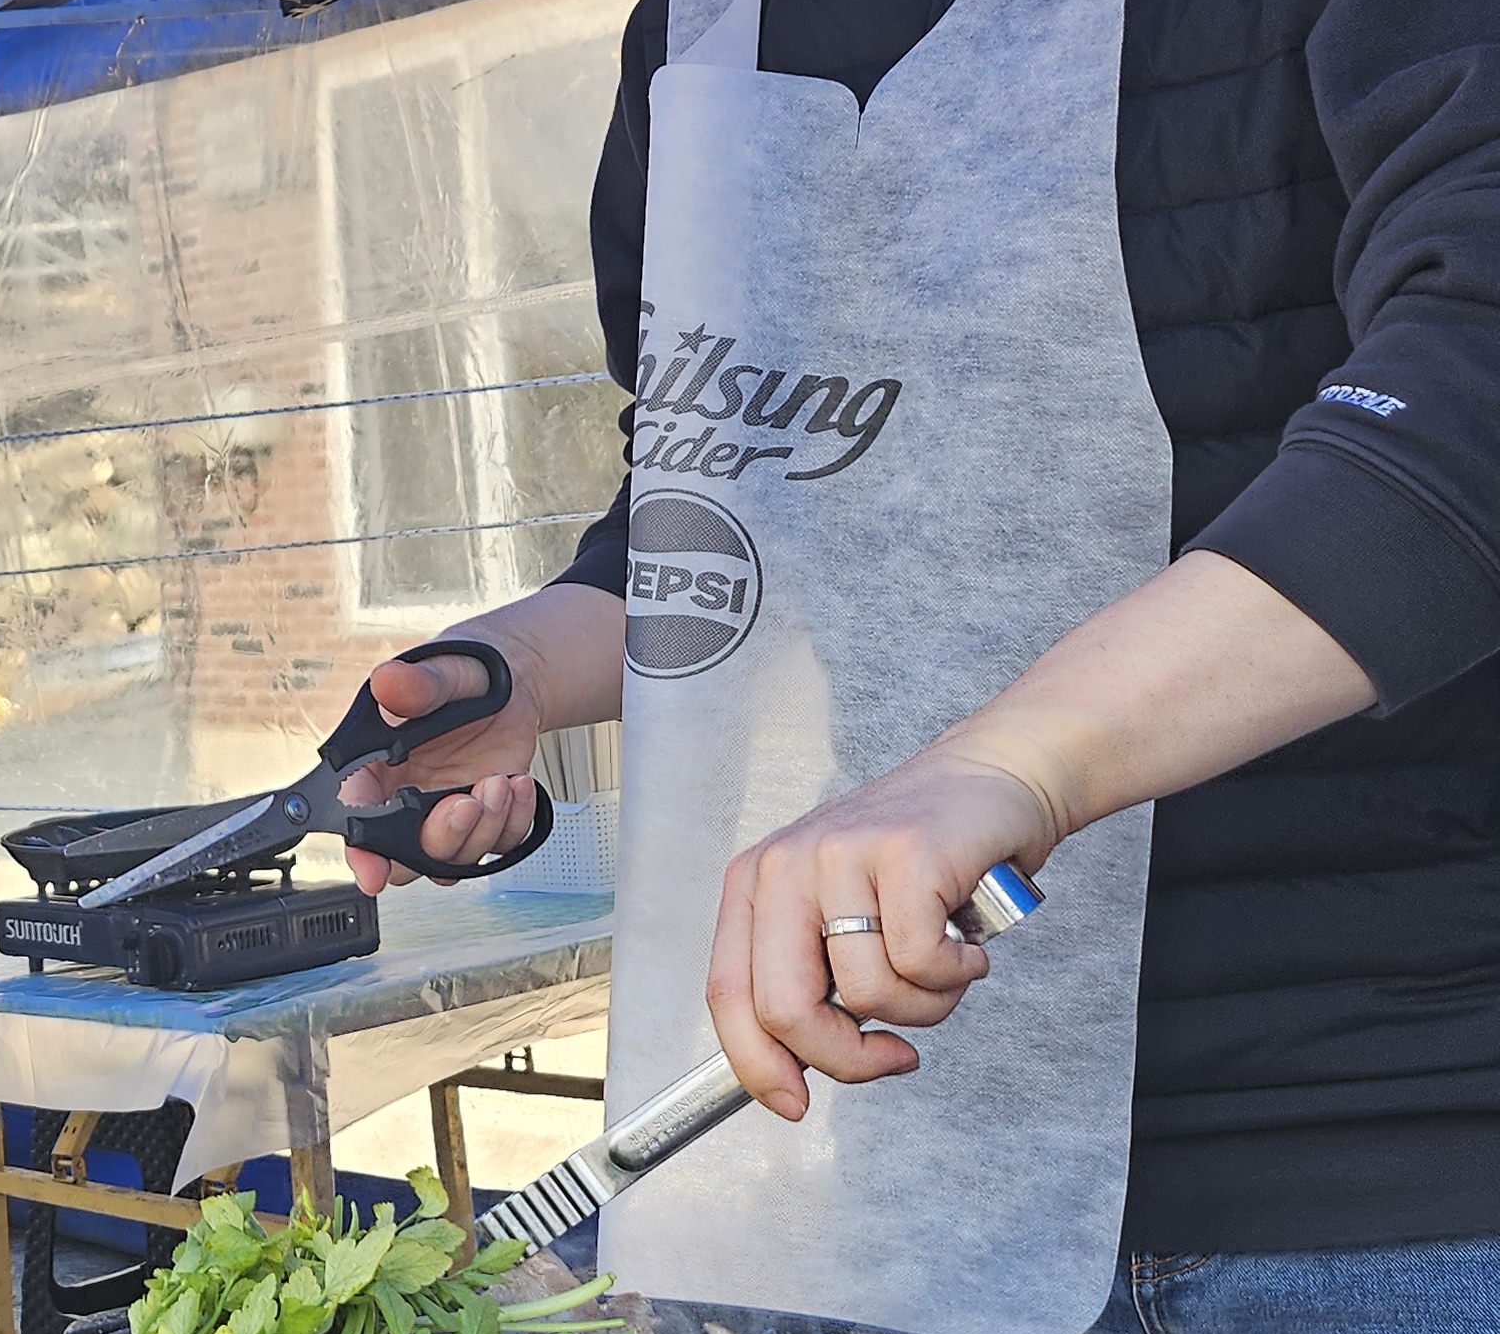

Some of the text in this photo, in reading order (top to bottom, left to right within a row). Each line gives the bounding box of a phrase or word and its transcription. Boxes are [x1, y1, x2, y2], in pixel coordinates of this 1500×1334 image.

[634, 301, 903, 481] hilsung
[627, 558, 748, 614] EPSI
[5, 918, 82, 946] SUNTOUCH
